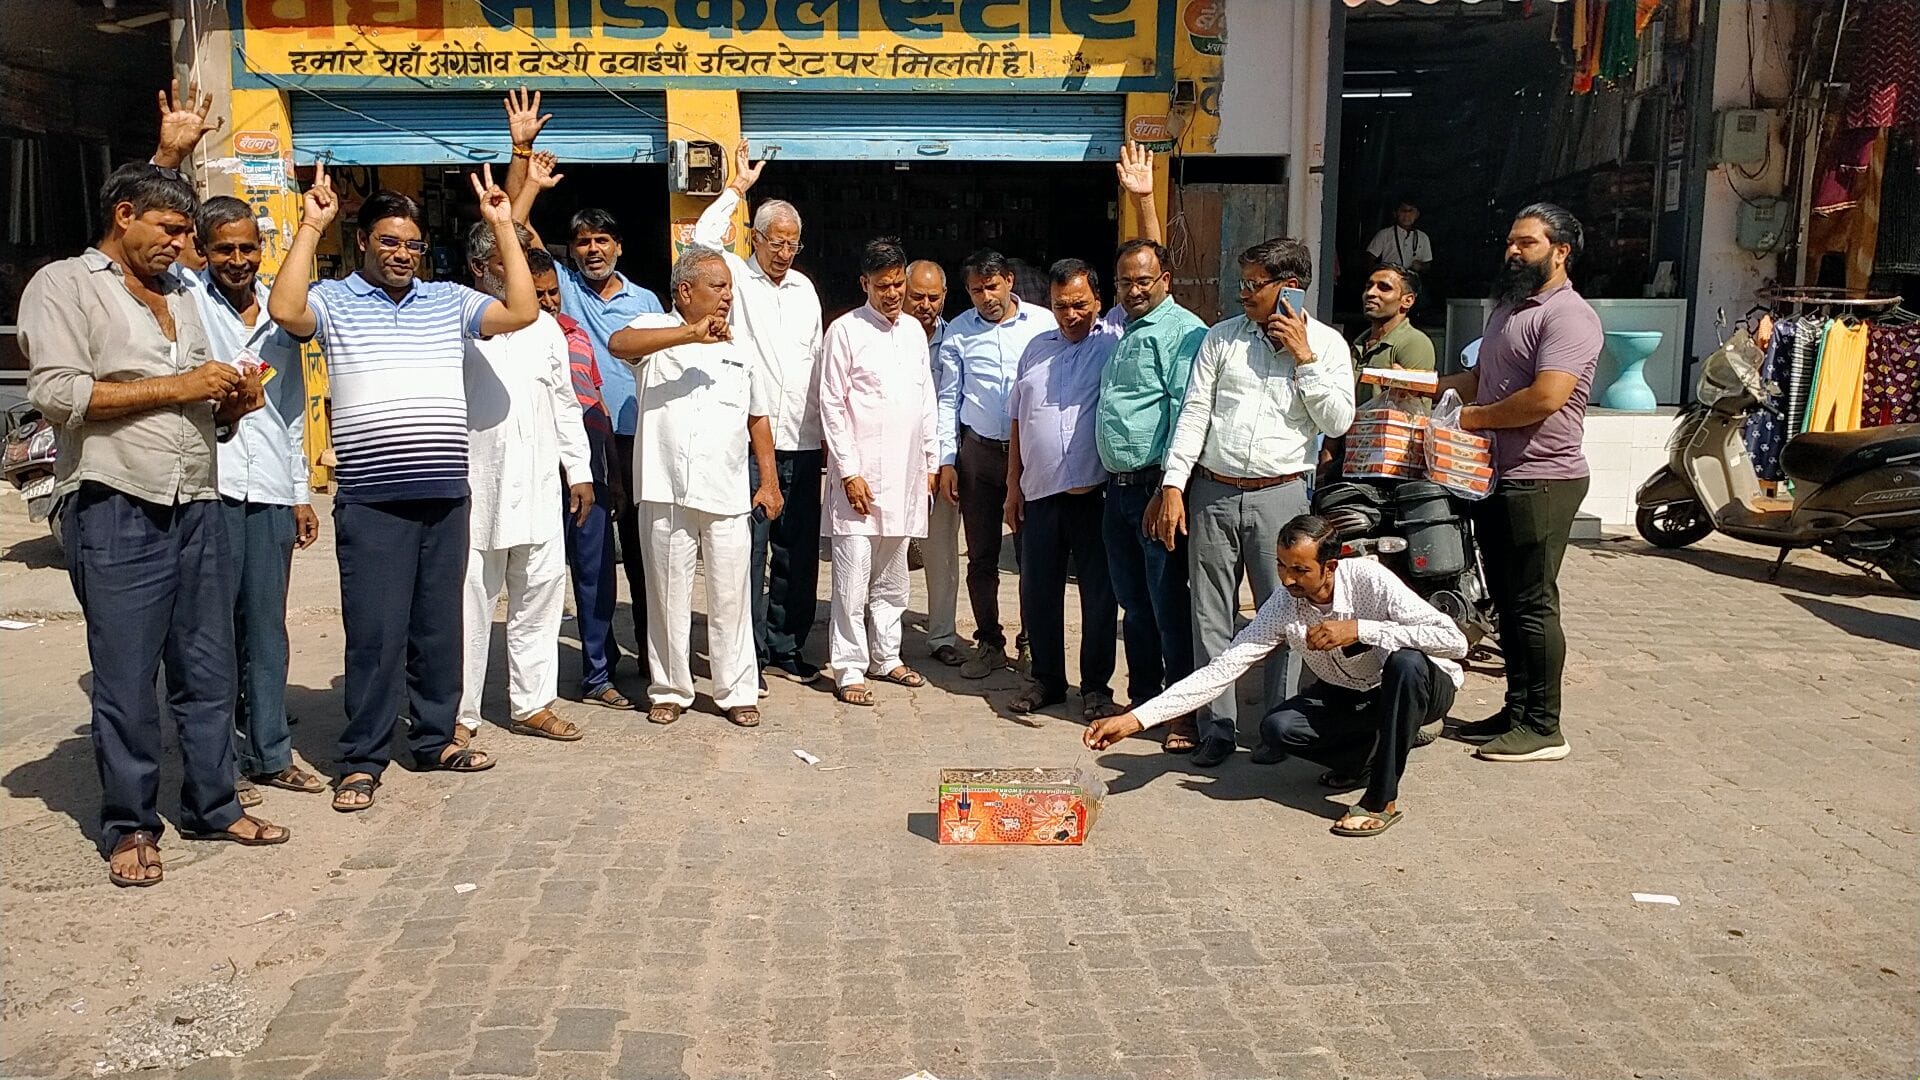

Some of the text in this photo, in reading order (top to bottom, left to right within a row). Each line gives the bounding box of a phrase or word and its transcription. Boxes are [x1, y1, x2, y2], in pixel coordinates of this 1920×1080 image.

[288, 42, 368, 74] हमारे
[374, 42, 427, 76] यहाँ
[518, 42, 596, 75] देशी
[599, 42, 688, 74] दवाईयाँ
[694, 45, 776, 75] उचित
[777, 43, 829, 76] रेट
[832, 51, 878, 76] पर
[886, 44, 1000, 77] मिलती
